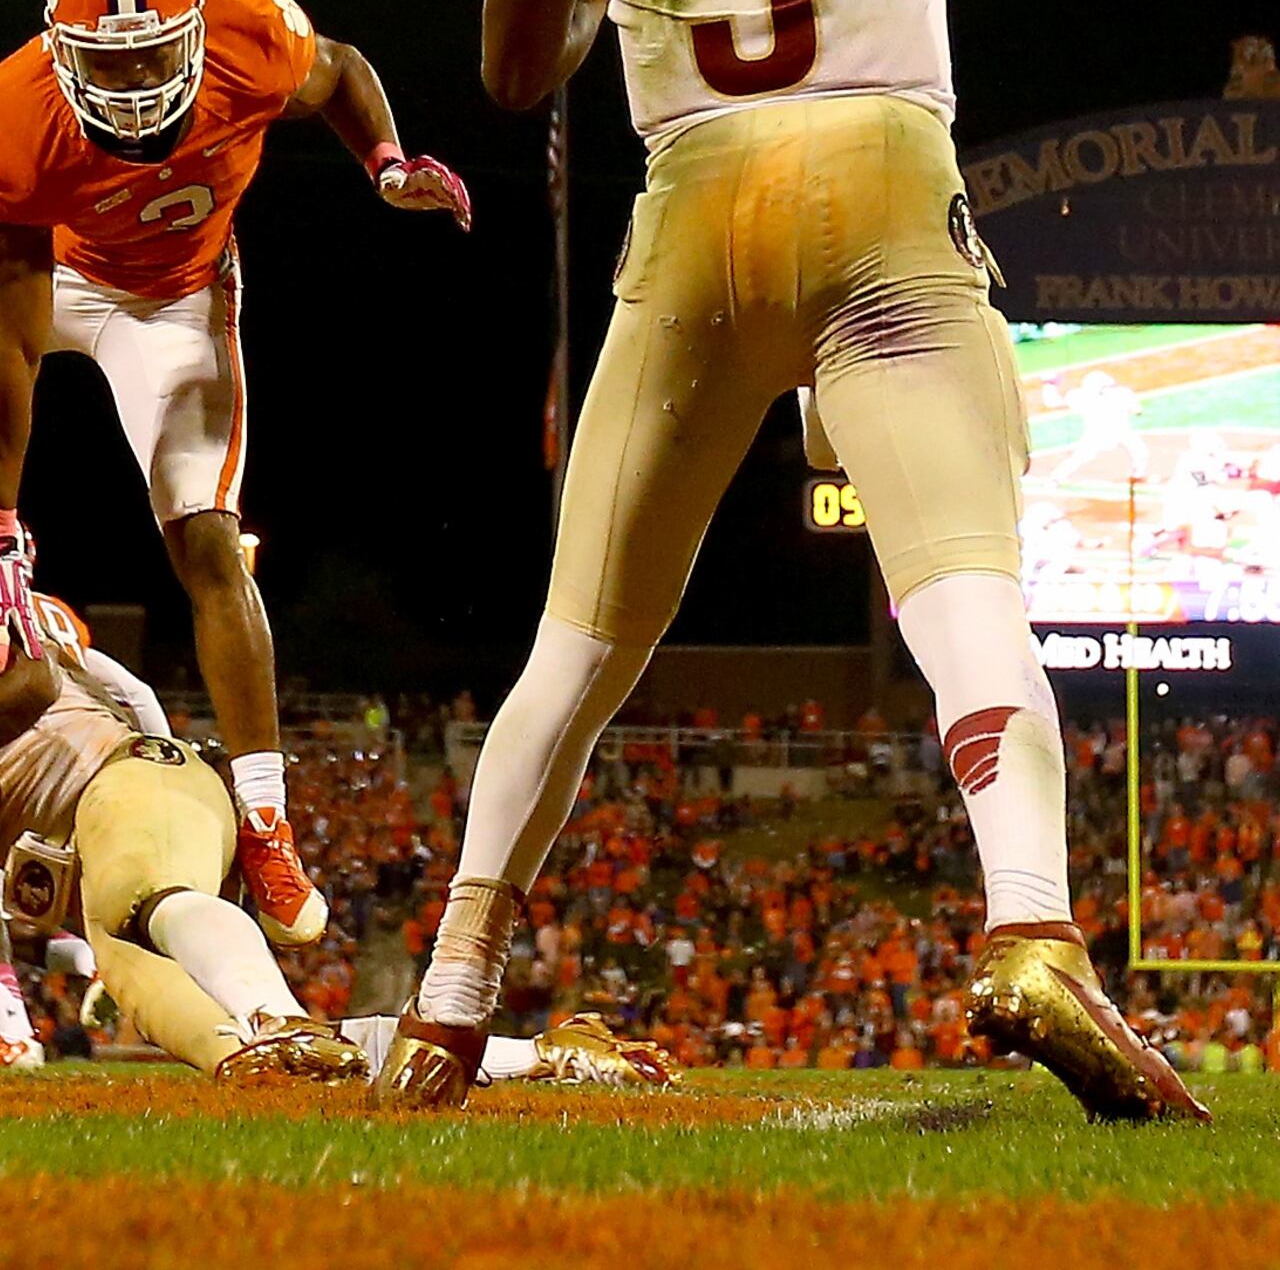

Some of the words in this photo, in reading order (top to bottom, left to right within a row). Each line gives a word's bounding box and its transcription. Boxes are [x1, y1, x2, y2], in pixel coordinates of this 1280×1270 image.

[963, 114, 1277, 217] EMORIAL
[1035, 275, 1179, 310] FRANK
[812, 483, 866, 527] 05
[1102, 632, 1233, 670] HEALTH
